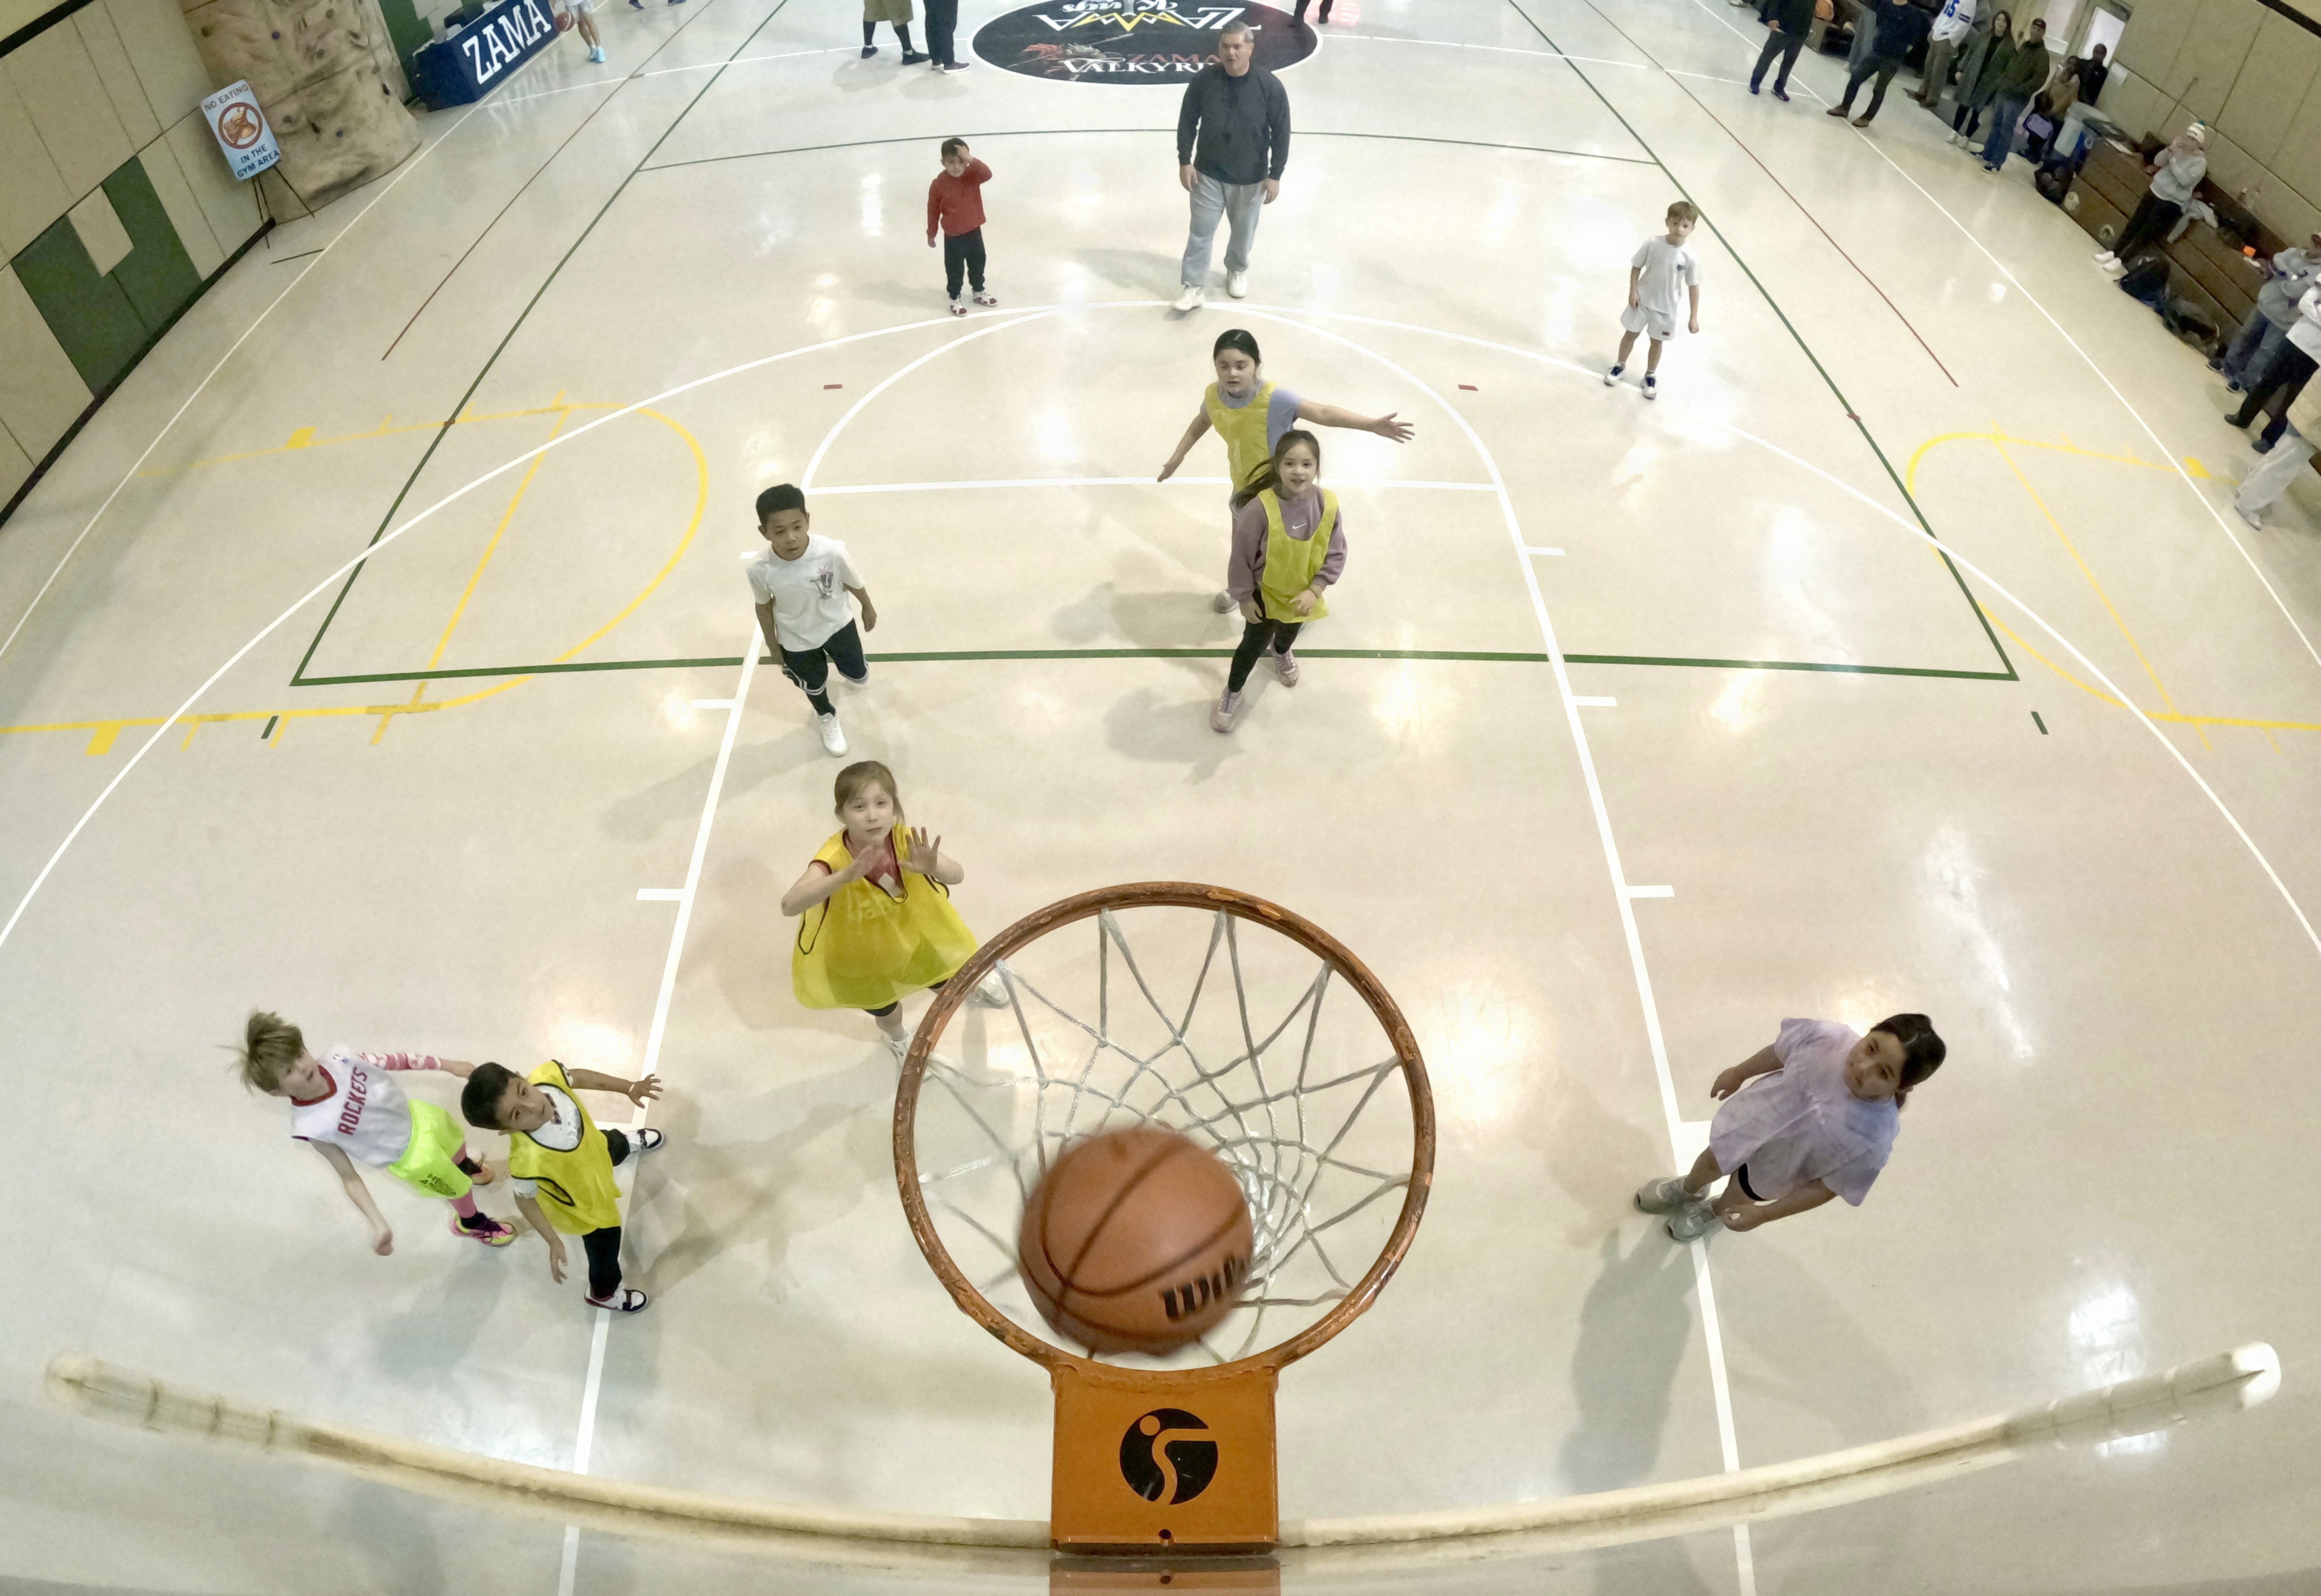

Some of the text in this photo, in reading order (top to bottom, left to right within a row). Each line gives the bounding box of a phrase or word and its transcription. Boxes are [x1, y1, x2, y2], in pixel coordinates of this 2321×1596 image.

[461, 0, 552, 84] ZAMA
[1128, 53, 1221, 63] ZAMA
[204, 84, 249, 112] NO EATING
[237, 150, 280, 177] GYM AREA
[240, 144, 268, 164] IN THE
[338, 1066, 368, 1135] ROCKETS
